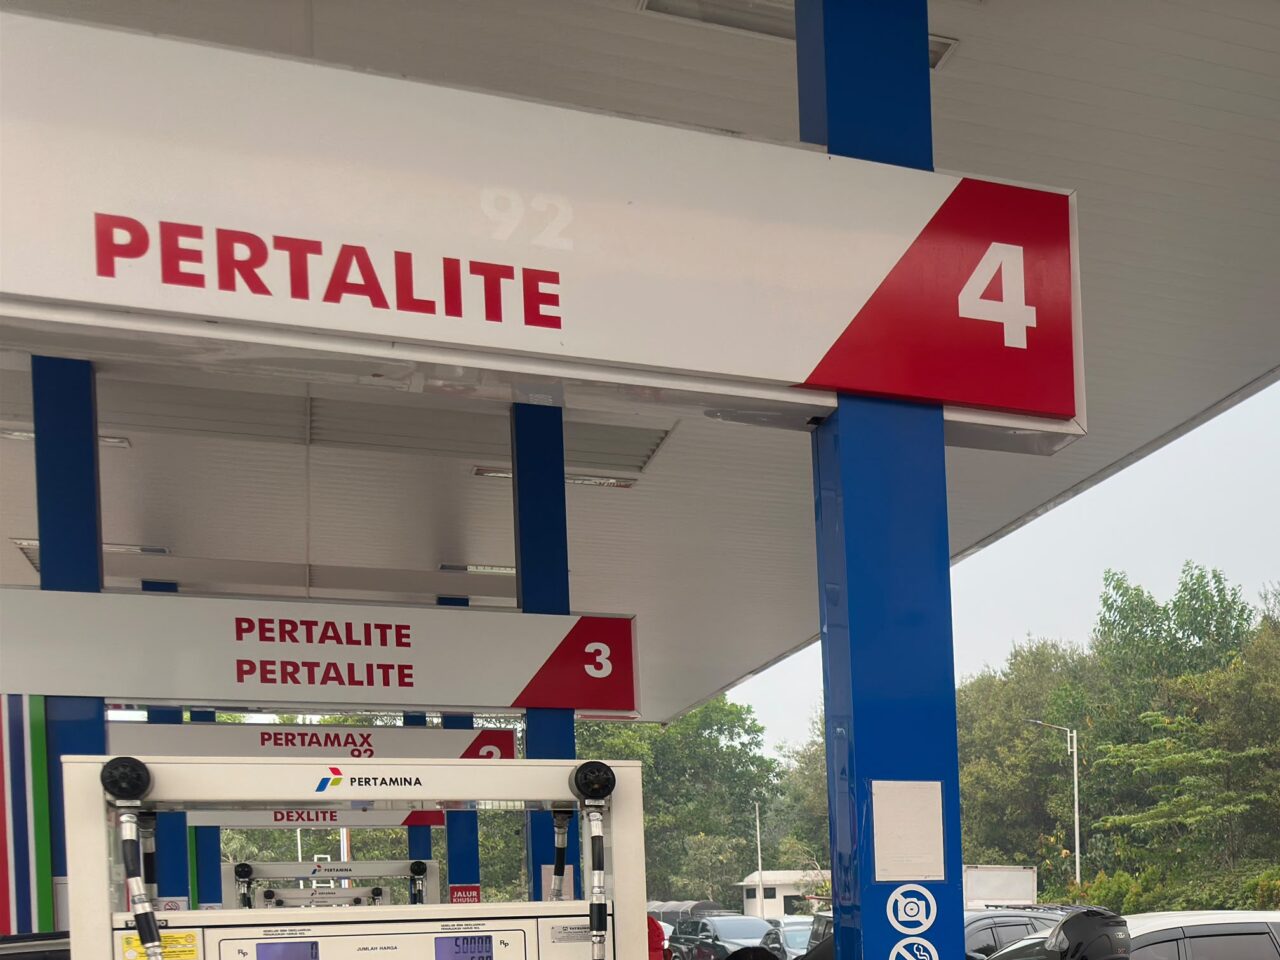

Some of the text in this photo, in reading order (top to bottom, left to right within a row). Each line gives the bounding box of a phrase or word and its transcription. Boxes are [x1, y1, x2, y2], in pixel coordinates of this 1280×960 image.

[480, 186, 573, 250] 92
[95, 213, 562, 329] PERTALITE
[957, 242, 1037, 350] 4
[235, 617, 412, 648] PERTALITE
[236, 660, 414, 688] PERTALITE
[584, 642, 612, 678] 3
[260, 731, 374, 748] PERTAMAX
[350, 777, 423, 787] PERTAMINA
[273, 810, 337, 823] DEXLITE
[238, 949, 248, 957] Rp
[500, 940, 509, 948] Rp
